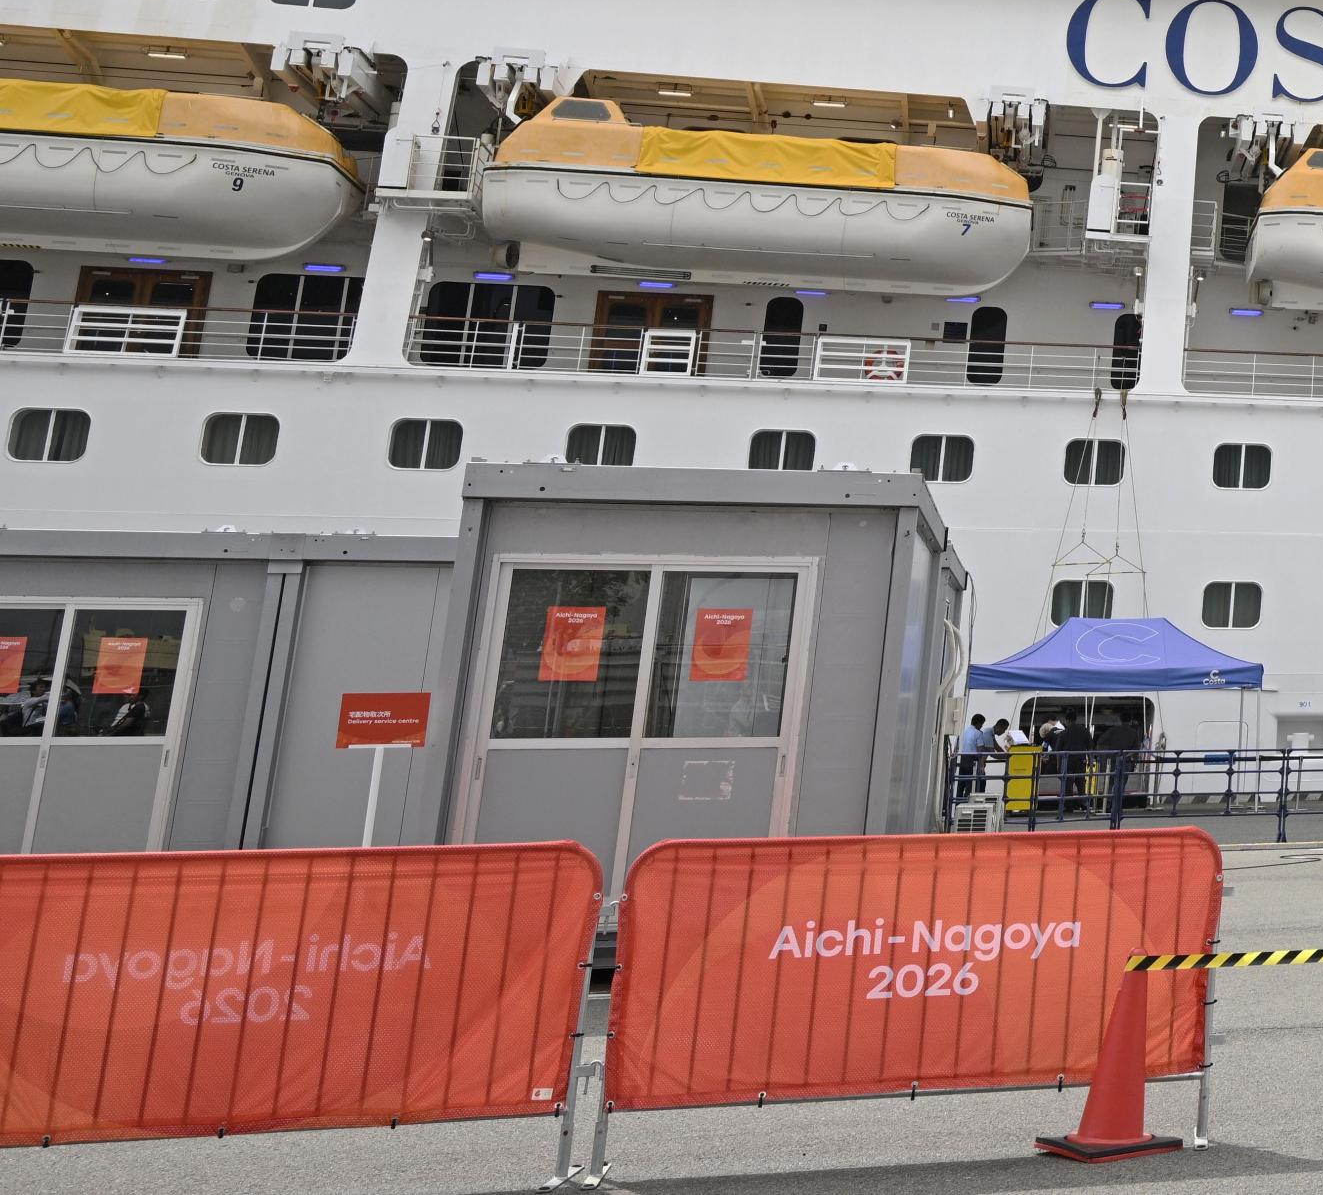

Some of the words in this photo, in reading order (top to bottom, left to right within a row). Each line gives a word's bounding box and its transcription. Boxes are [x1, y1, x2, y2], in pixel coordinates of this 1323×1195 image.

[212, 162, 240, 172] COSTA
[242, 166, 275, 177] SERENA
[232, 177, 244, 192] 9
[946, 211, 968, 220] COSTA
[970, 214, 995, 223] SERENA
[961, 223, 972, 236] 7
[1202, 678, 1226, 686] Costa
[768, 917, 1082, 962] Aichi-Nagoya
[866, 962, 980, 1000] 2026
